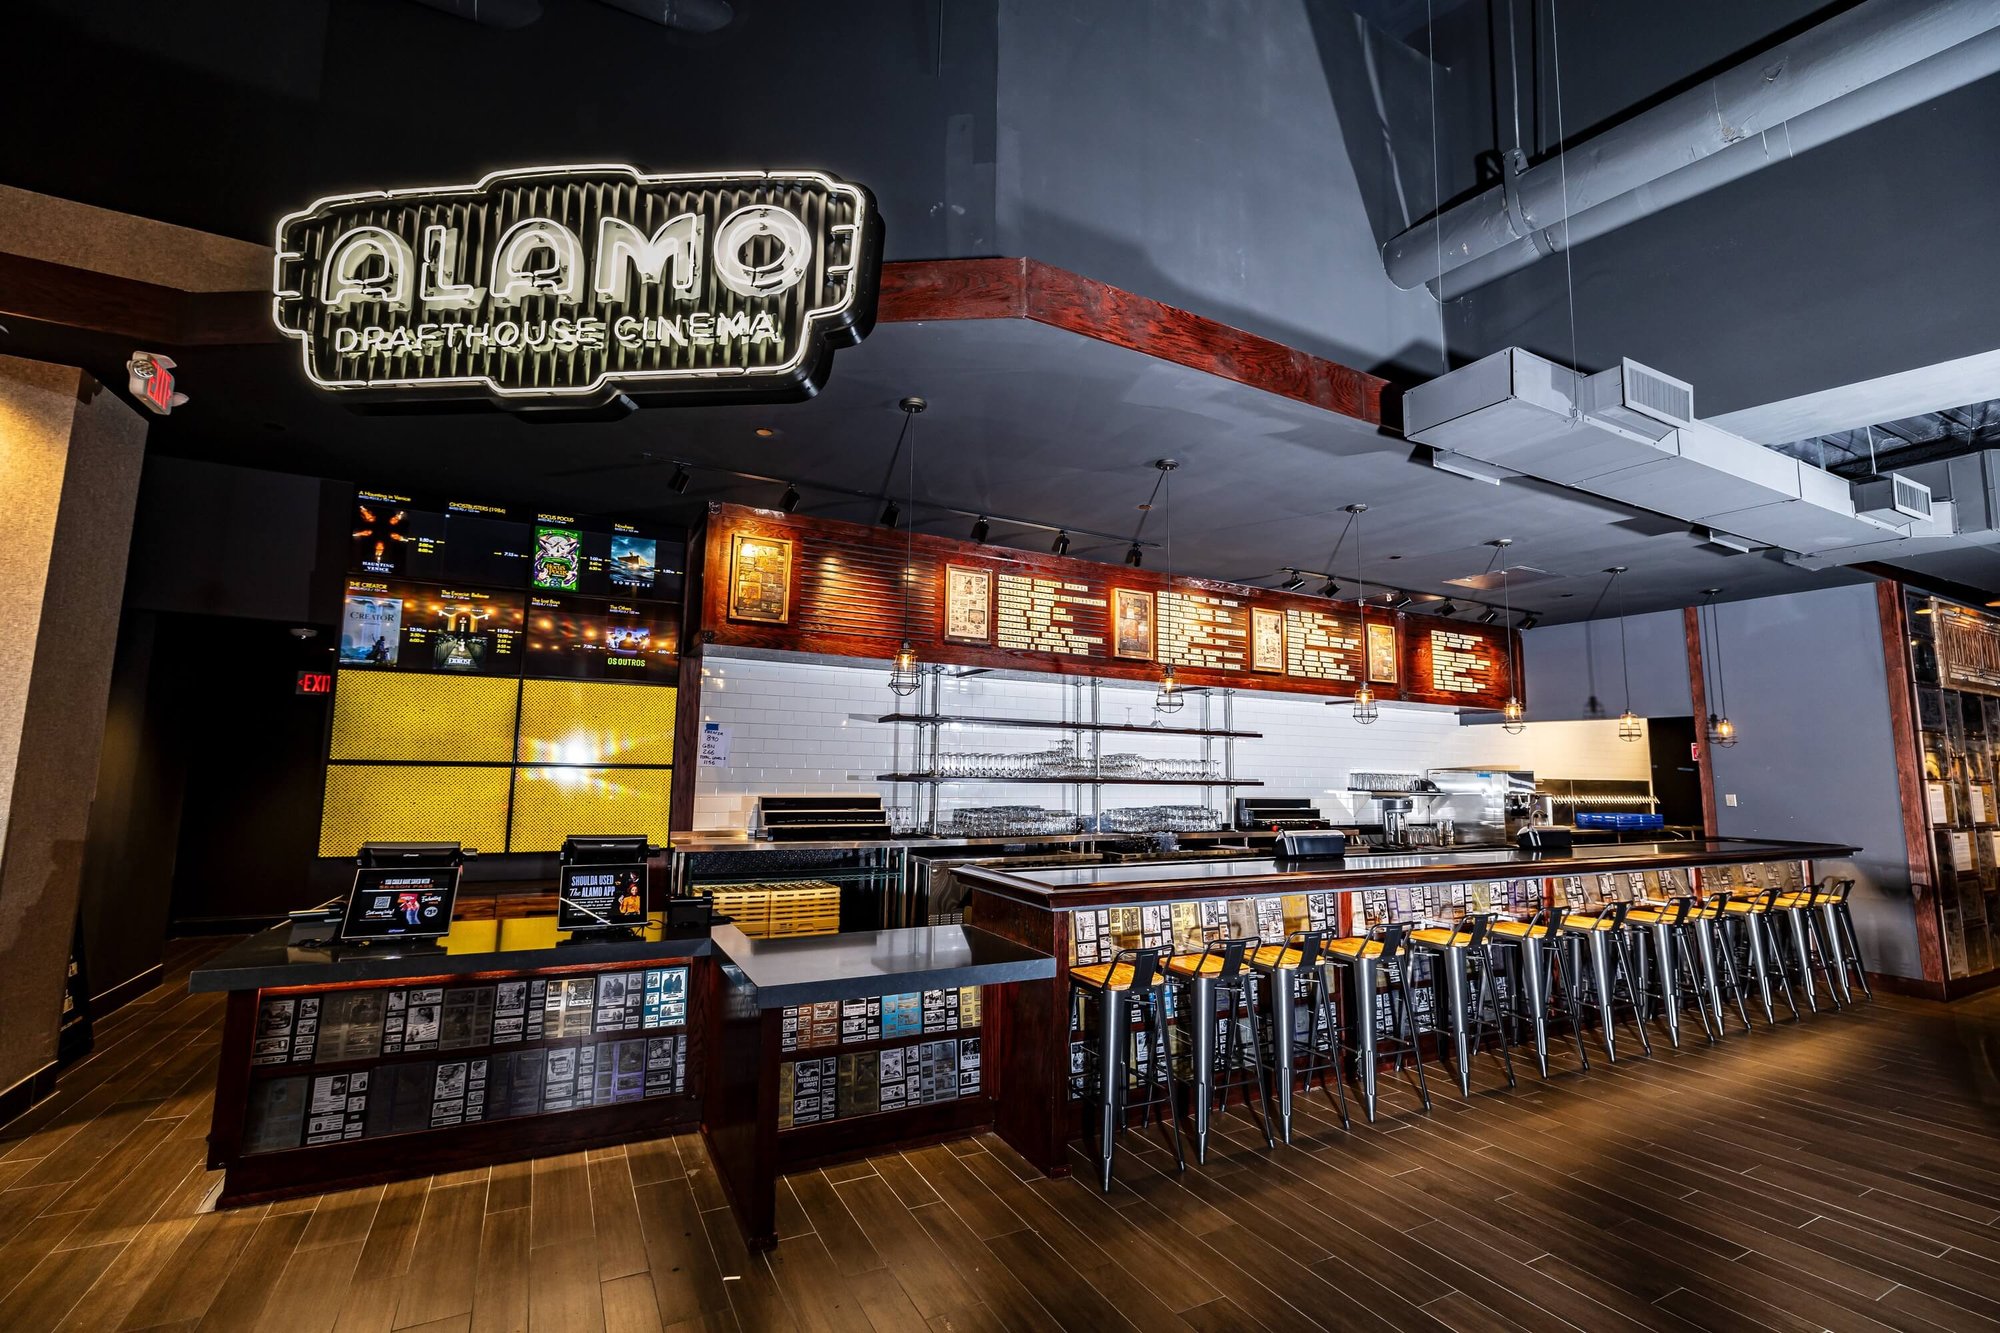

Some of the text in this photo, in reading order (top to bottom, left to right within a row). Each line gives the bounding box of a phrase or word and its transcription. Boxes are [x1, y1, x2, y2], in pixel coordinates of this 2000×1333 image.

[321, 204, 812, 310] ALAMO
[335, 310, 782, 355] DRAFTHOUSE CINEMA
[998, 574, 1032, 585] ALLAGASH
[998, 594, 1032, 604] BROOKLYN
[350, 611, 394, 622] CREATOR
[998, 627, 1039, 638] DORCHESTER
[998, 634, 1032, 644] DOWNEAST
[1038, 644, 1051, 652] THE
[1072, 648, 1089, 656] MEOW
[608, 657, 645, 667] OS OUTROS
[572, 875, 614, 886] SHOULDA USED
[569, 886, 615, 897] The ALAMO APP
